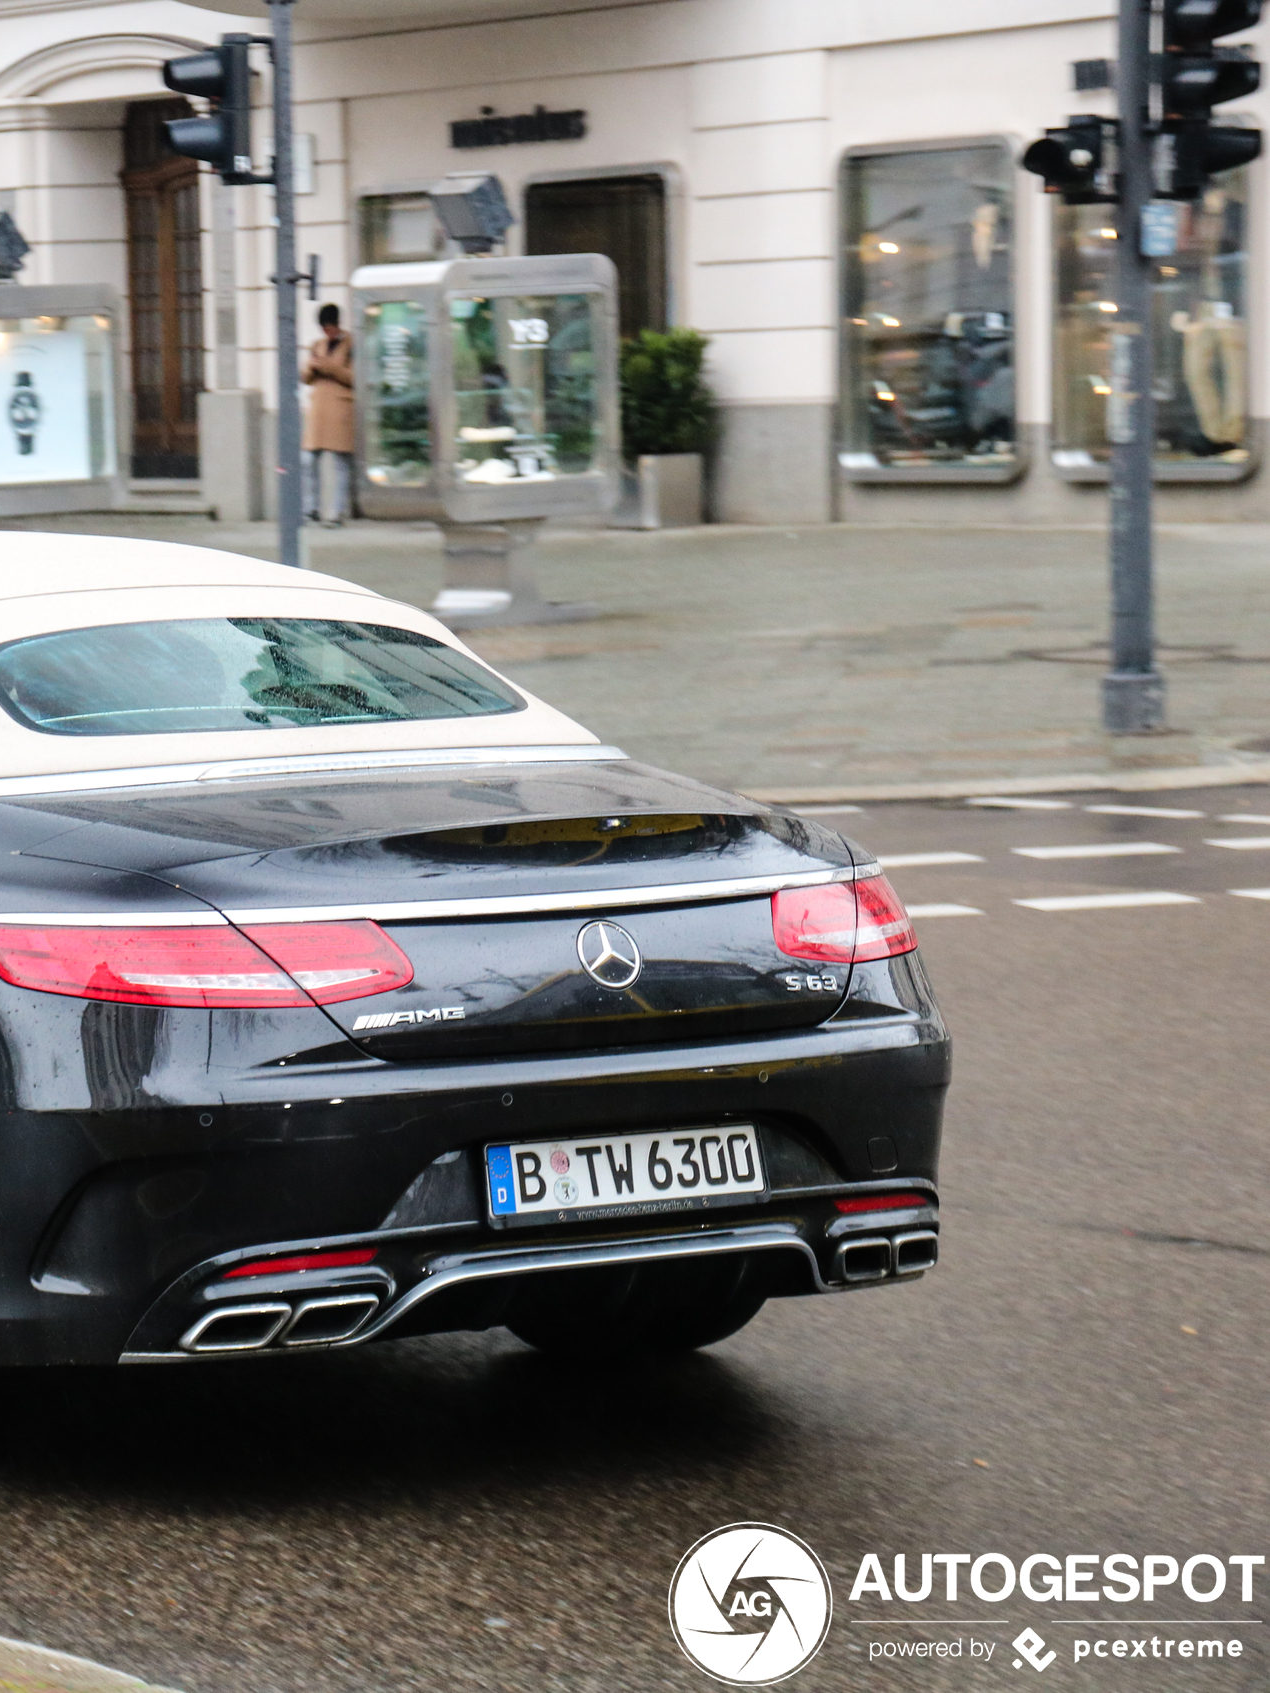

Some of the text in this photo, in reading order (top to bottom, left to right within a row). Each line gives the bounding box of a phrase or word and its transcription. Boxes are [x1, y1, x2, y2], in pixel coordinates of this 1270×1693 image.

[785, 975, 838, 991] S 63
[497, 1133, 756, 1204] D B TW 6300
